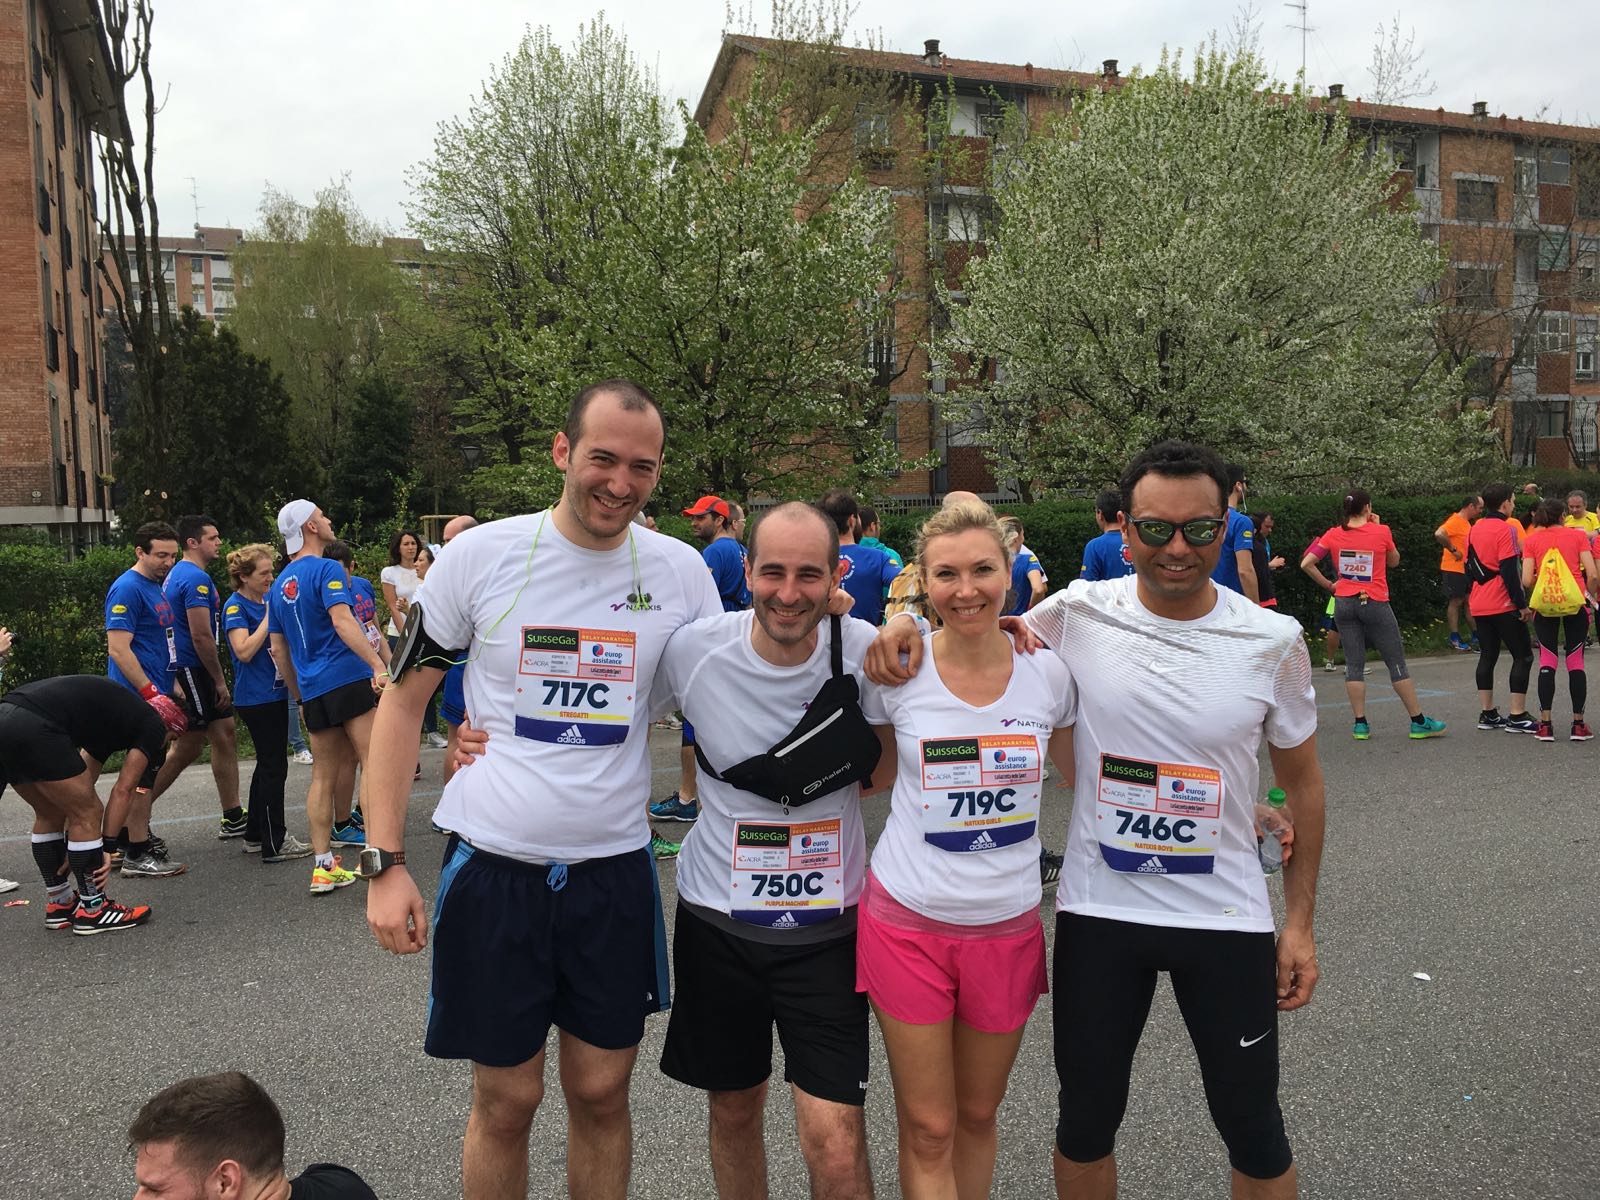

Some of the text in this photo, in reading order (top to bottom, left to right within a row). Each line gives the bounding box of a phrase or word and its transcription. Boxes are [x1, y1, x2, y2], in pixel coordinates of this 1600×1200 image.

[1344, 564, 1367, 572] 724D
[605, 651, 623, 659] europ
[592, 657, 623, 665] assistance
[542, 680, 610, 709] 717C
[557, 735, 586, 744] adidas
[1007, 755, 1027, 763] europ
[994, 762, 1027, 770] assistance
[1182, 771, 1219, 780] MARATHON
[1185, 788, 1206, 796] europ
[947, 788, 1017, 817] 719C
[1171, 793, 1206, 803] assistance
[1116, 809, 1197, 843] 746C
[969, 841, 997, 851] adidas
[801, 847, 829, 855] assistance
[751, 871, 824, 898] 750C
